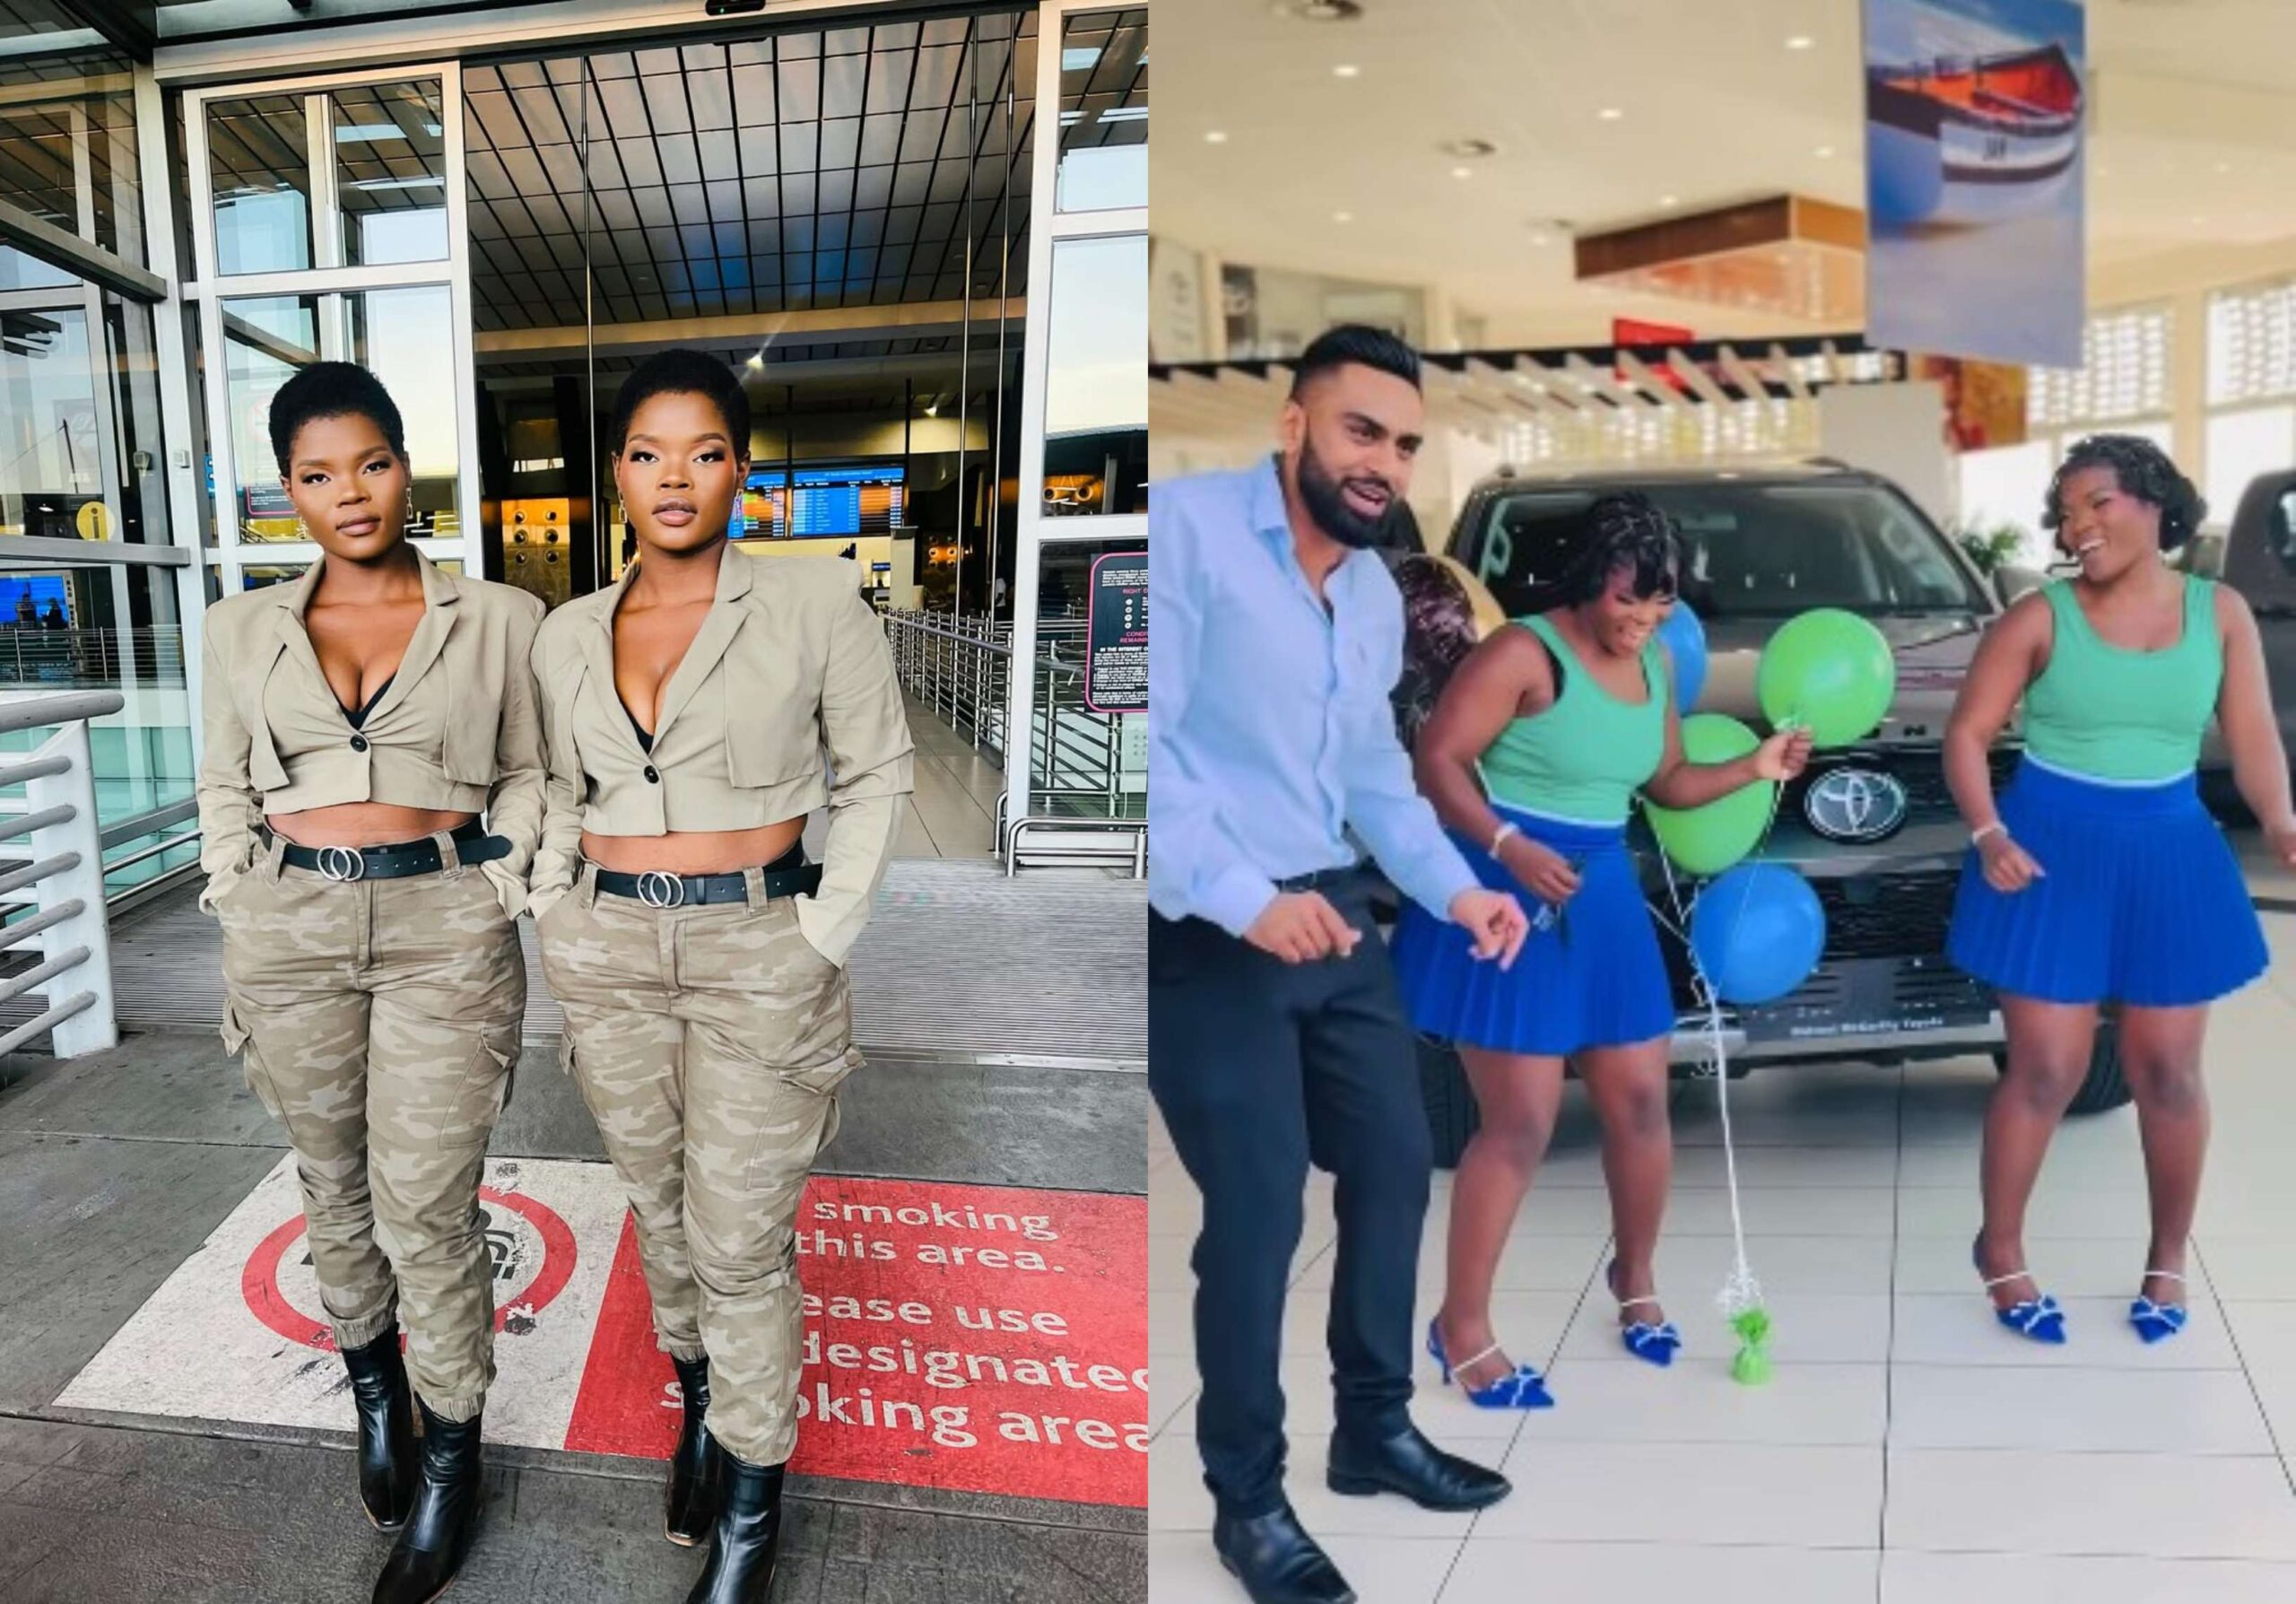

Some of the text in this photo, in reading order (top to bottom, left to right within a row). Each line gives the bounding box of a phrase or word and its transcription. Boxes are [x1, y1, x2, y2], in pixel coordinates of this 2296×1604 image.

[813, 1201, 1059, 1241] smoking
[795, 1229, 1065, 1273] this area.
[803, 1294, 1068, 1336] ease use
